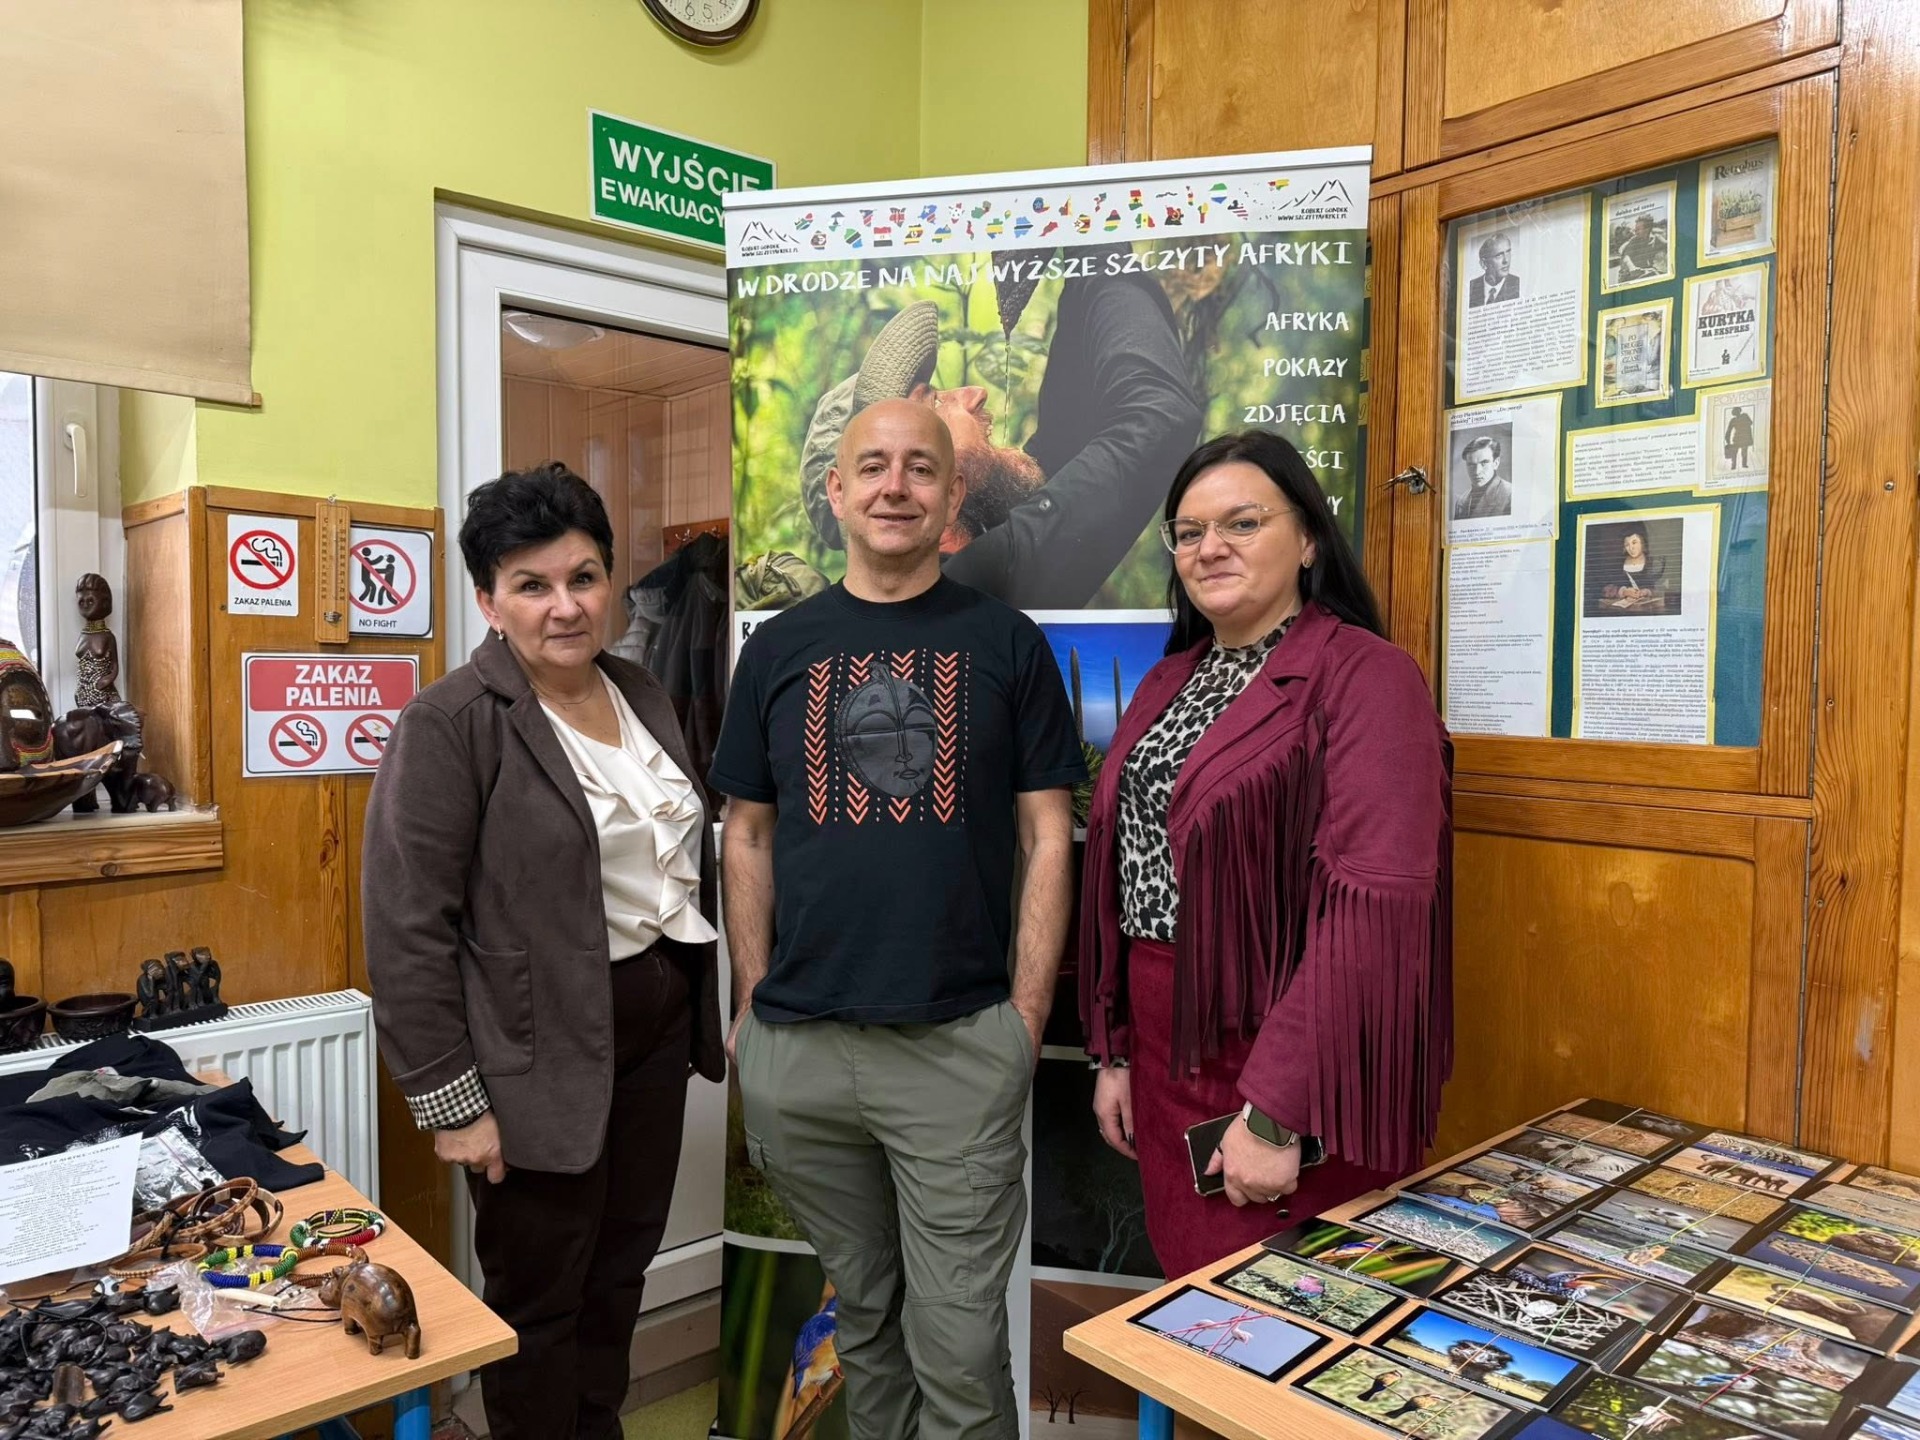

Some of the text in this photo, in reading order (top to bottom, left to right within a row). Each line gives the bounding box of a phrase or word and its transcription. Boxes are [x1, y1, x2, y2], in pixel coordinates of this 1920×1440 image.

[703, 3, 713, 19] 5
[608, 137, 760, 197] WYJŚCIE
[737, 276, 760, 299] W
[765, 269, 872, 296] DRODZE
[878, 266, 917, 288] NA
[1104, 244, 1232, 276] SZCZYTY
[1238, 241, 1352, 266] AFRYKI
[1265, 311, 1349, 332] AFRYKA
[1697, 309, 1755, 329] KURTKA
[1701, 329, 1713, 338] NA
[1714, 324, 1750, 336] EKSPRES
[1263, 357, 1348, 378] POKAZY
[1243, 403, 1346, 425] ZDJĘCIA
[234, 597, 292, 608] ZAKAZ PALENIA
[359, 618, 398, 629] NO FIGHT
[295, 664, 373, 685] ZAKAZ
[286, 687, 382, 707] PALENIA
